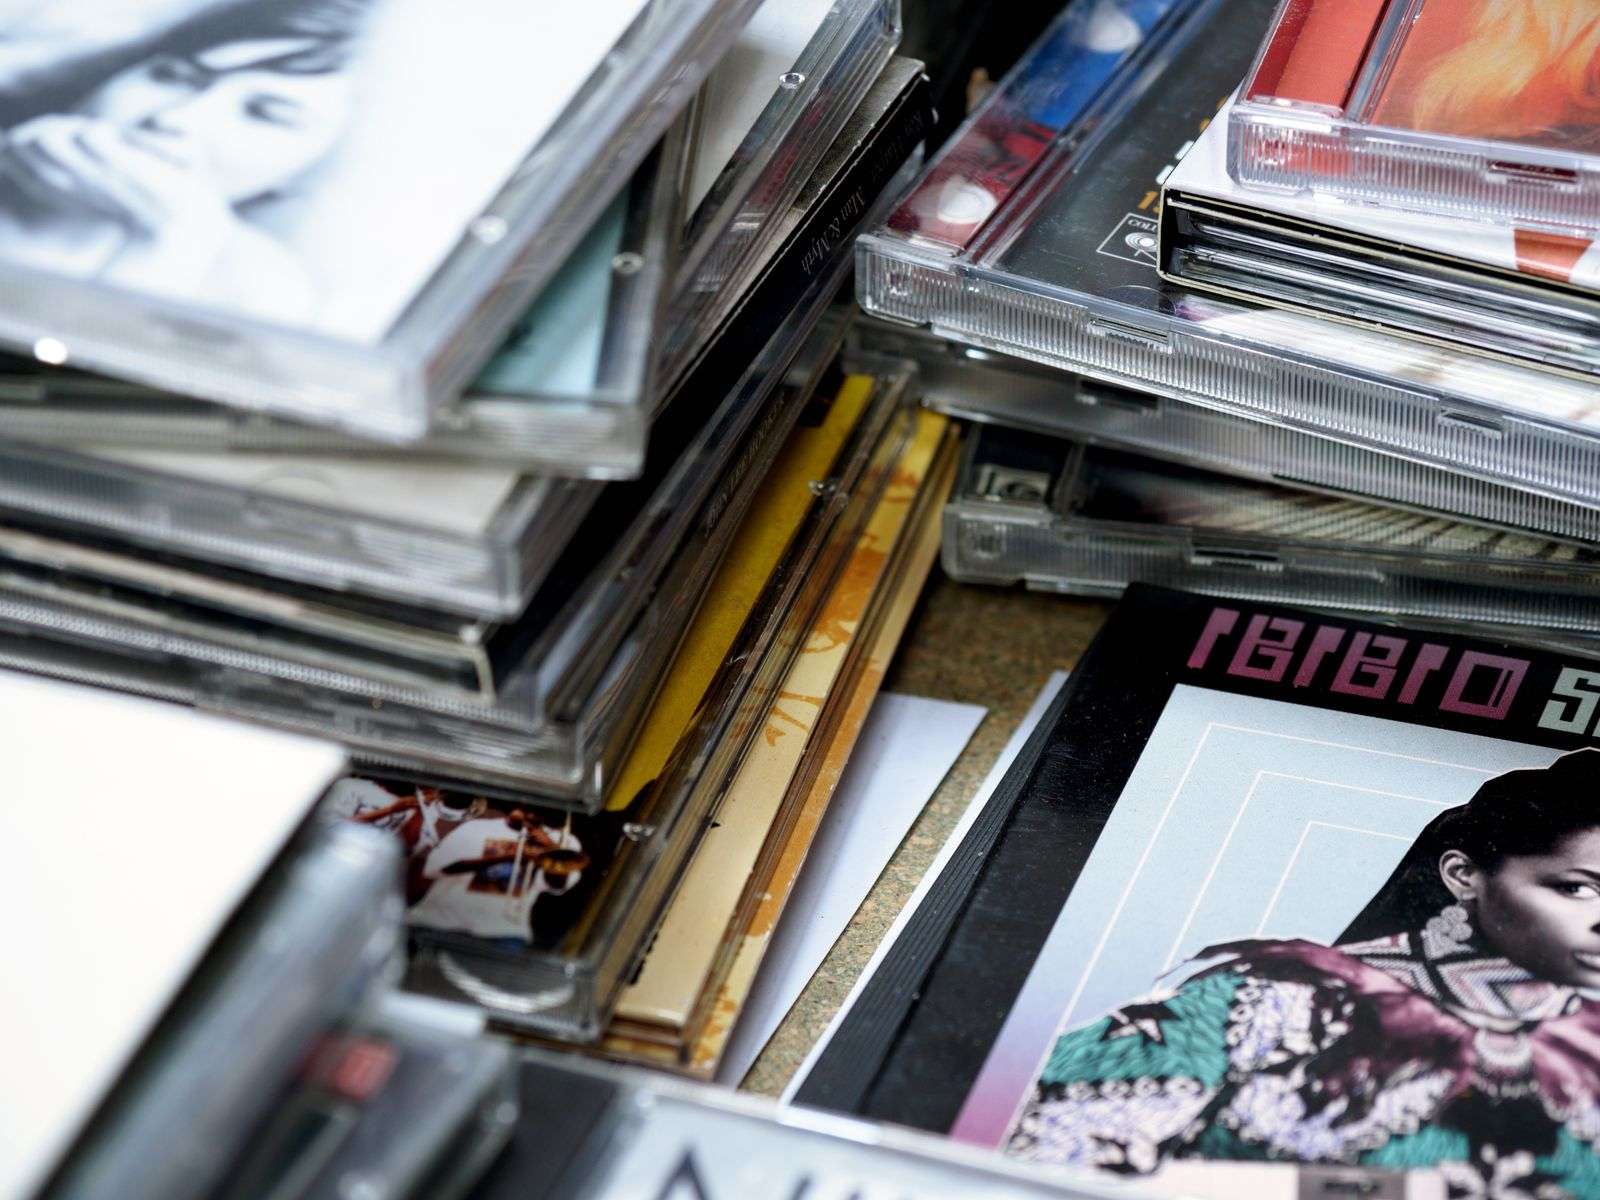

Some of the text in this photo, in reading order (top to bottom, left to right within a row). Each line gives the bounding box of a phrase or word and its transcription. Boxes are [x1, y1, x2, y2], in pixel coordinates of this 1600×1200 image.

[828, 217, 842, 238] &
[801, 230, 831, 275] Myth
[1537, 667, 1600, 738] S
